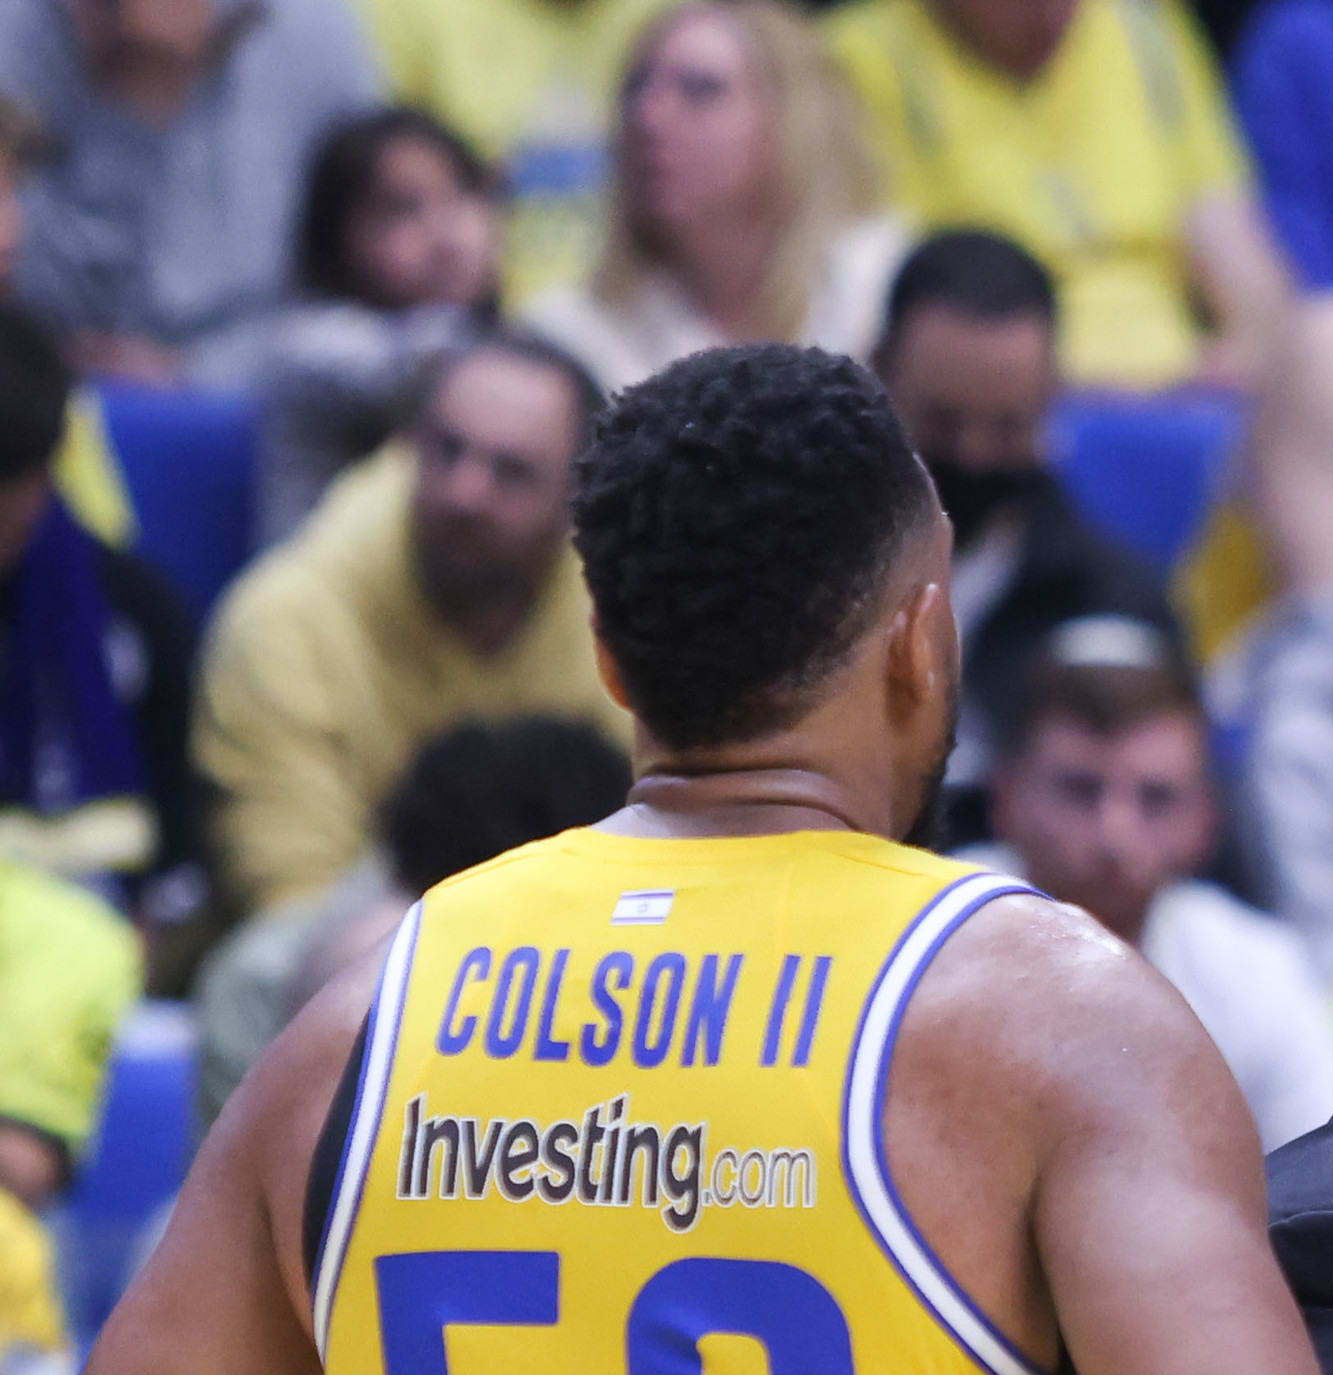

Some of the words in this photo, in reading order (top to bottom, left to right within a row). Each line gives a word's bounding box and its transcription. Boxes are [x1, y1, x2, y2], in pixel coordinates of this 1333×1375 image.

[436, 946, 744, 1068] COLSON
[761, 954, 831, 1068] II
[397, 1094, 816, 1232] Investing.com
